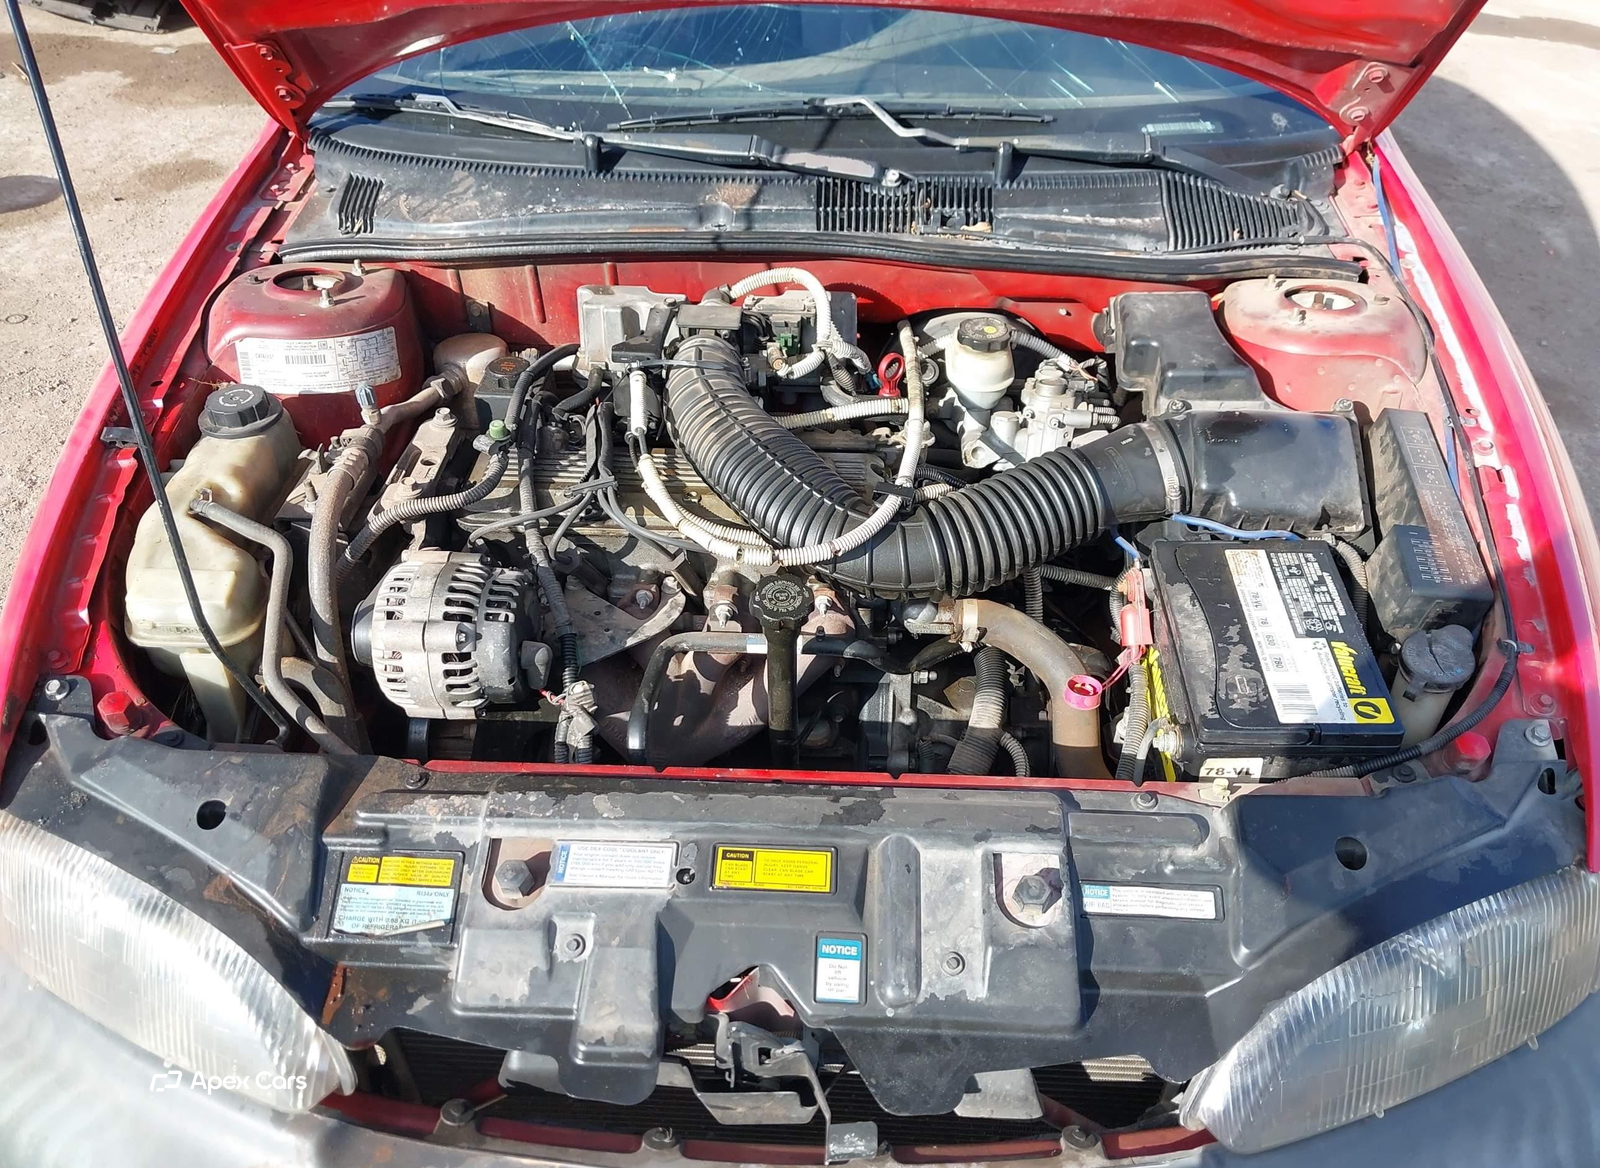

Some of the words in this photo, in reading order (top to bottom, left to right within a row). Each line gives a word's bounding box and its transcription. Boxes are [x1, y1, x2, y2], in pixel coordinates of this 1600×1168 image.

[1330, 641, 1366, 696] Valucraft
[1204, 767, 1255, 776] 78-VL
[358, 856, 380, 864] CAUTION
[558, 850, 568, 874] NOTICE
[1084, 888, 1109, 897] NOTICE
[822, 945, 858, 956] NOTICE
